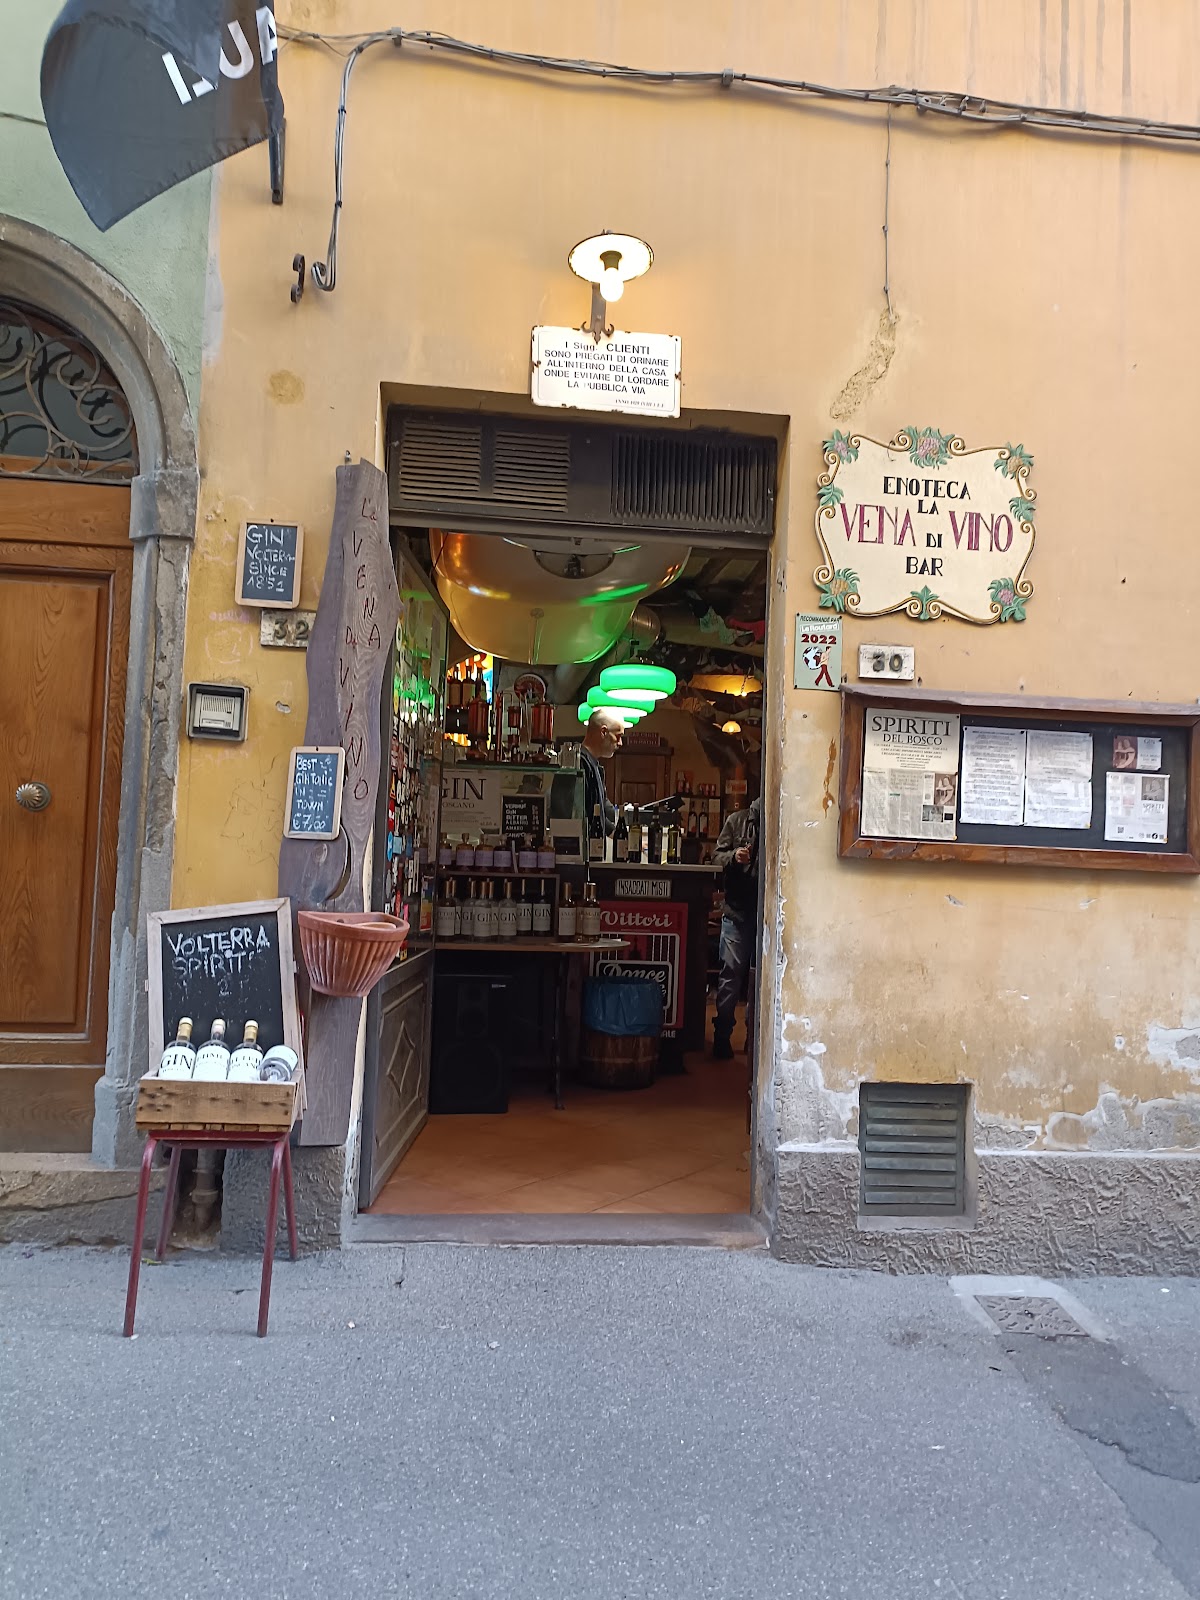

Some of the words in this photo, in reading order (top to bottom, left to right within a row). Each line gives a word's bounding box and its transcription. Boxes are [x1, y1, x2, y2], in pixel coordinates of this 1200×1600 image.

[606, 343, 650, 355] CLIENTI
[544, 349, 571, 359] SONO
[575, 352, 613, 362] PREGATI
[617, 354, 626, 363] DI
[629, 356, 669, 367] ORINARE
[547, 359, 605, 371] ALL'INTERNO
[609, 364, 638, 375] DELLA
[642, 366, 667, 377] CASA
[544, 369, 570, 378] ONDE
[574, 371, 610, 382] EVITARE
[614, 373, 624, 383] DI
[627, 376, 670, 387] LORDARE
[567, 380, 579, 389] LA
[631, 385, 646, 395] VIA
[883, 476, 971, 500] ENOTECA
[917, 499, 939, 515] LA
[840, 503, 916, 547] VENA
[926, 533, 943, 548] DI
[949, 510, 1014, 553] VINO
[905, 556, 943, 577] BAR
[273, 618, 310, 641] 32
[801, 633, 837, 645] 2022
[872, 652, 903, 673] 30
[872, 716, 951, 736] SPIRITI
[883, 733, 904, 744] DEL
[907, 735, 943, 746] BOSCO
[442, 801, 475, 809] OSCANO
[618, 880, 649, 896] INSACCATI
[651, 881, 668, 896] MISTI
[500, 913, 517, 922] GIN
[517, 908, 532, 917] GIN
[535, 908, 551, 918] GIN
[600, 911, 673, 928] Vittori
[166, 925, 270, 956] VOLTERRA
[160, 1053, 194, 1070] GIN
